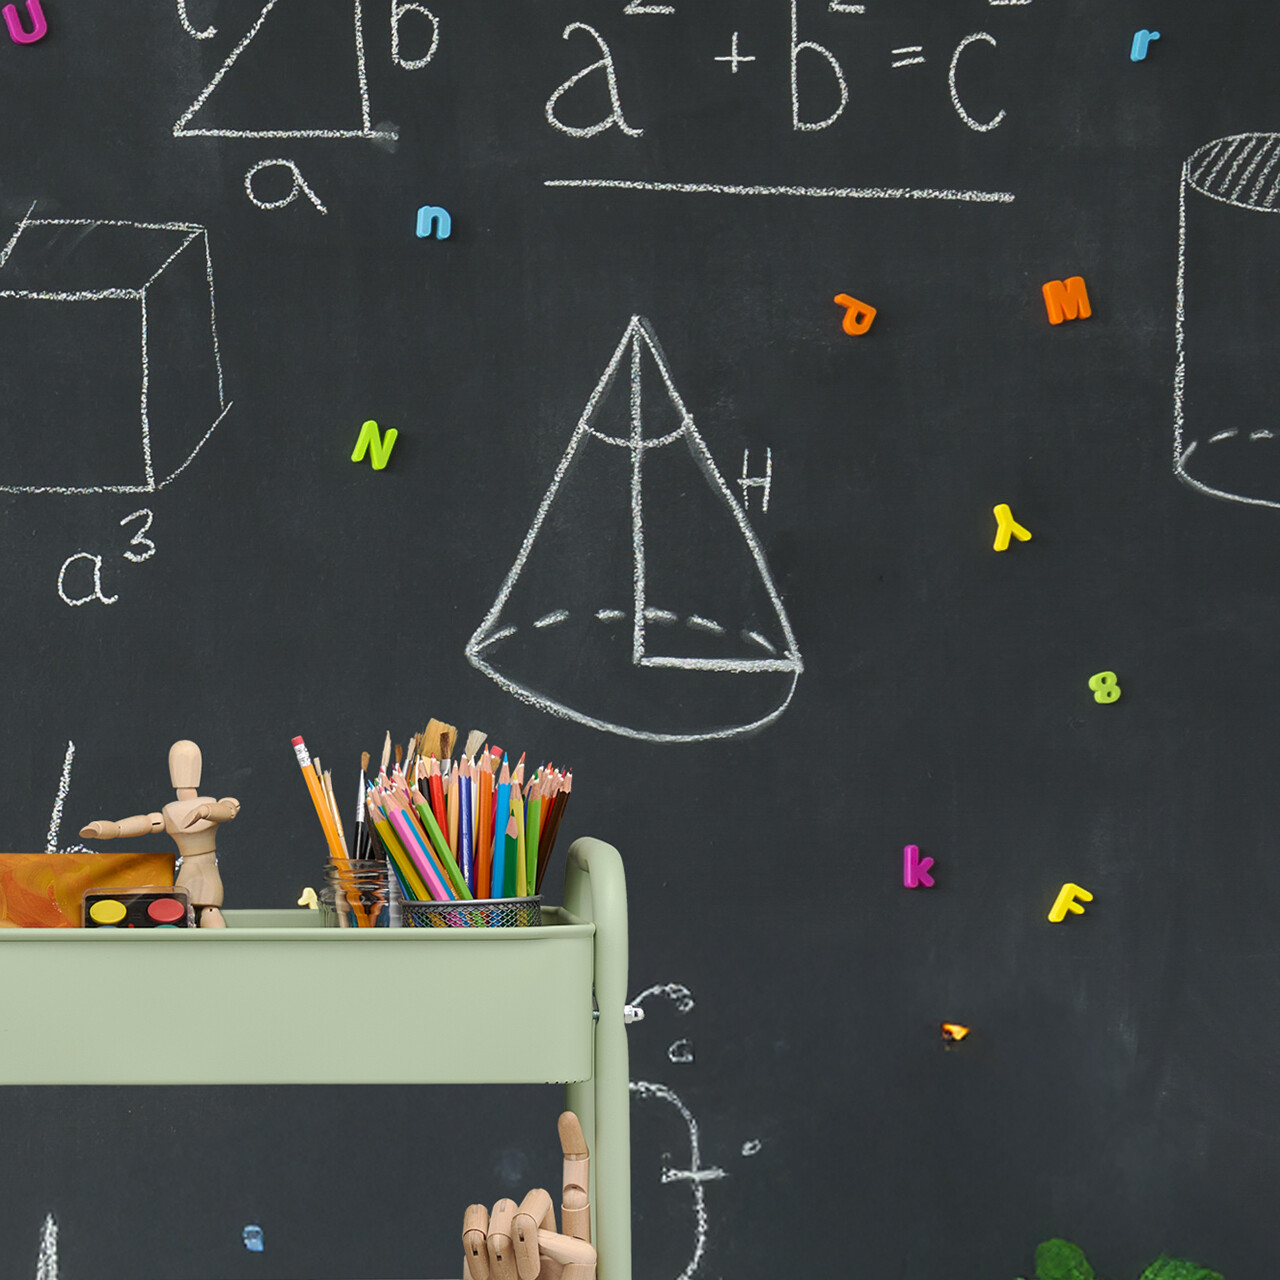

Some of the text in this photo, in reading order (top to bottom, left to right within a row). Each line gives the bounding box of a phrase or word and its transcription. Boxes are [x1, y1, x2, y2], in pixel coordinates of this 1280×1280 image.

[1040, 275, 1093, 326] M
[737, 447, 772, 514] H
[1048, 882, 1094, 923] F
